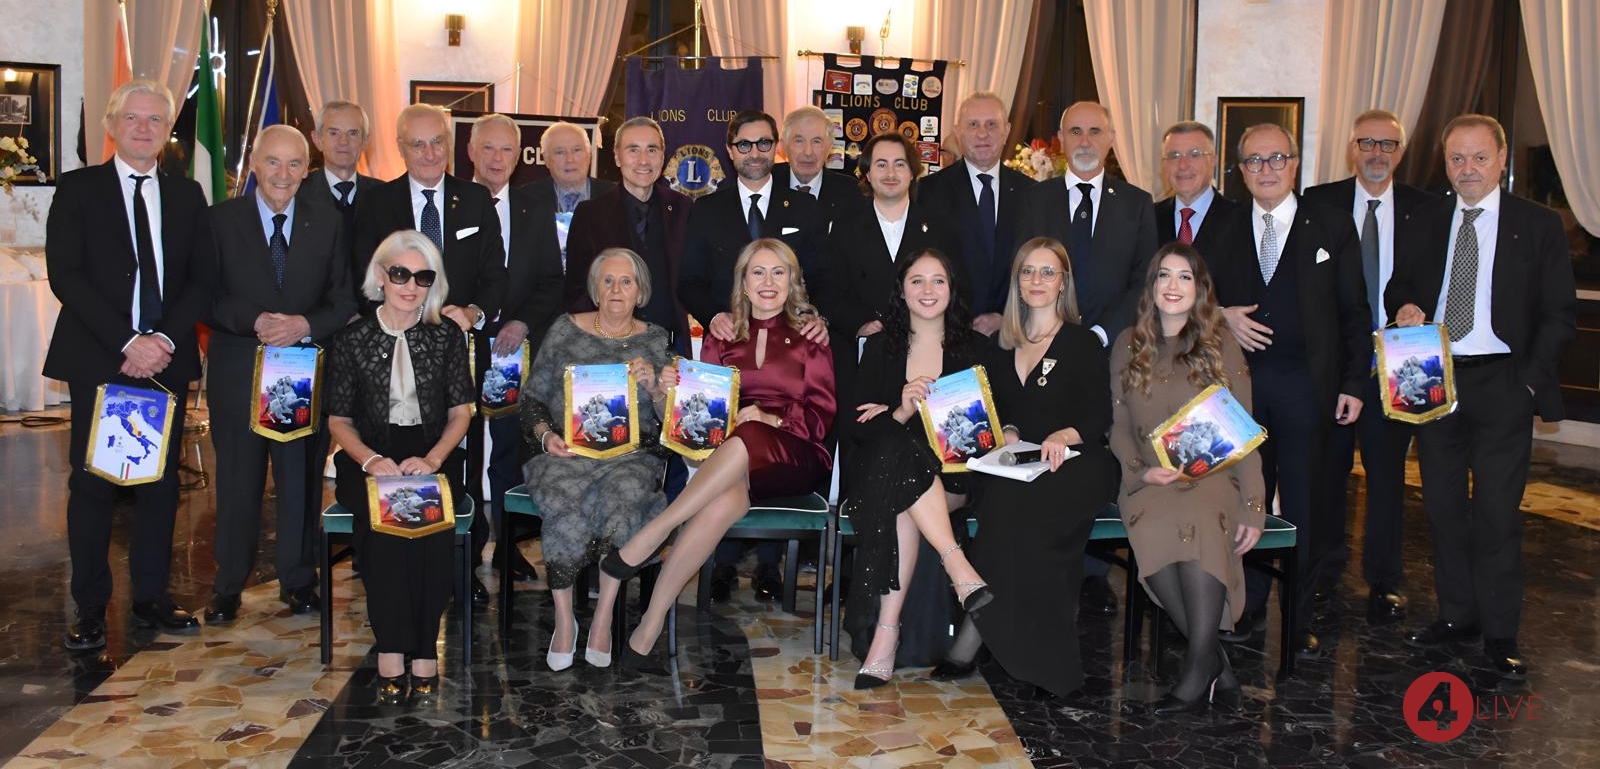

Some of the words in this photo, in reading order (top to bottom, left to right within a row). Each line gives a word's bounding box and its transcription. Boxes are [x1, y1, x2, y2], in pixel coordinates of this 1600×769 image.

[841, 94, 880, 108] LIONS
[894, 97, 928, 111] CLUB
[680, 146, 710, 159] LIONS
[686, 160, 702, 183] L
